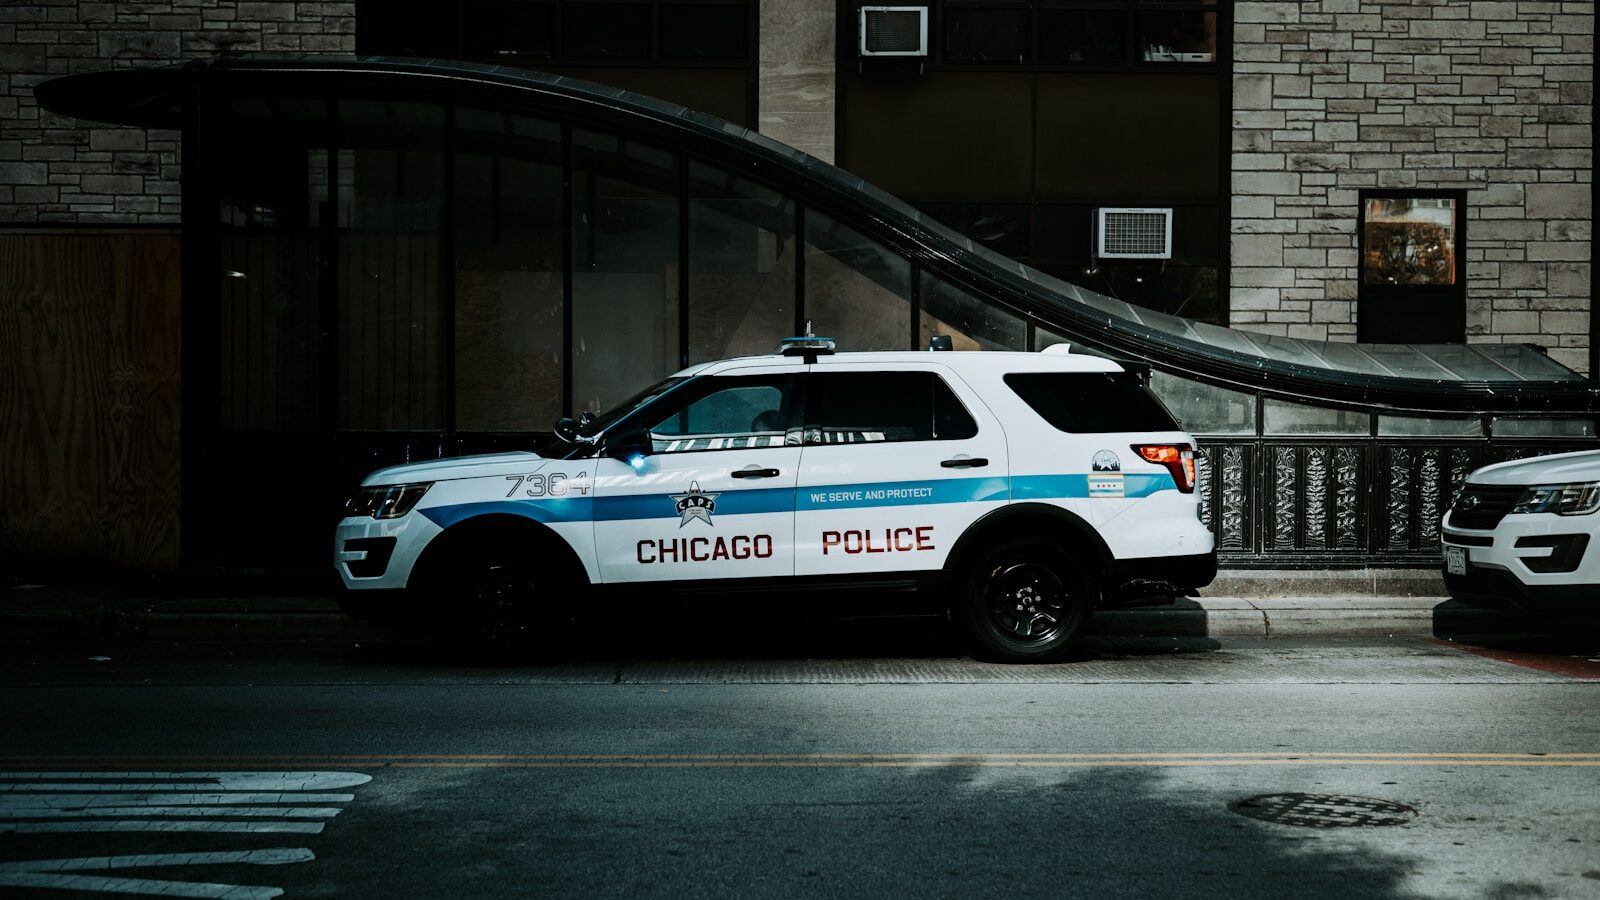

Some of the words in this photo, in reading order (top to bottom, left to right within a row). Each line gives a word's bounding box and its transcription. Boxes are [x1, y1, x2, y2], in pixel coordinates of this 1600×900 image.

[506, 471, 590, 498] 7364
[811, 493, 827, 503] WE
[828, 491, 862, 502] SERVE
[865, 489, 885, 500] AND
[888, 487, 933, 499] PROTECT
[678, 498, 713, 510] CAPS
[636, 534, 773, 564] CHICAGO
[822, 526, 936, 555] POLICE
